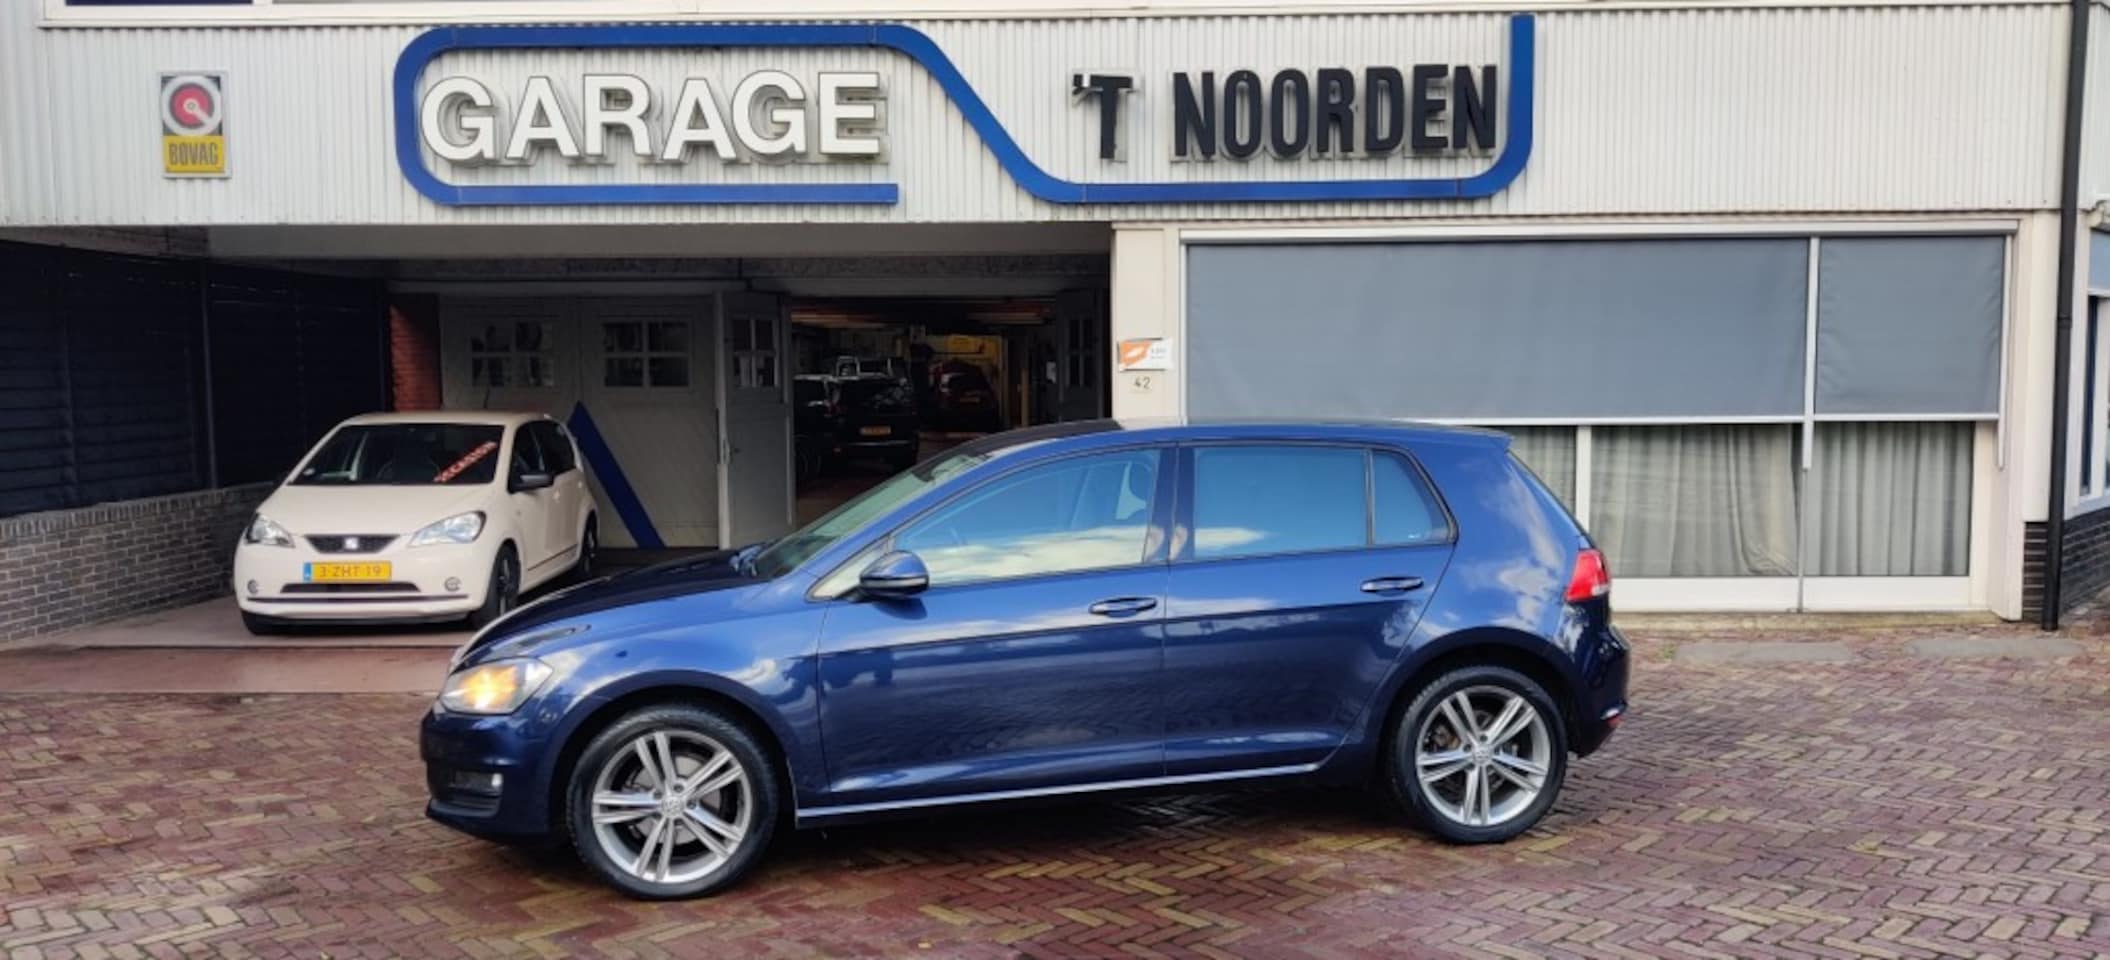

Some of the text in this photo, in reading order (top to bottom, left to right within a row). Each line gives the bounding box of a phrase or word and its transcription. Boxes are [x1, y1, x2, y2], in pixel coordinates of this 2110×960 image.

[421, 70, 881, 161] GARAGE
[1173, 65, 1498, 158] NOORDEN
[168, 143, 219, 166] BOVAG
[1133, 376, 1151, 390] 42
